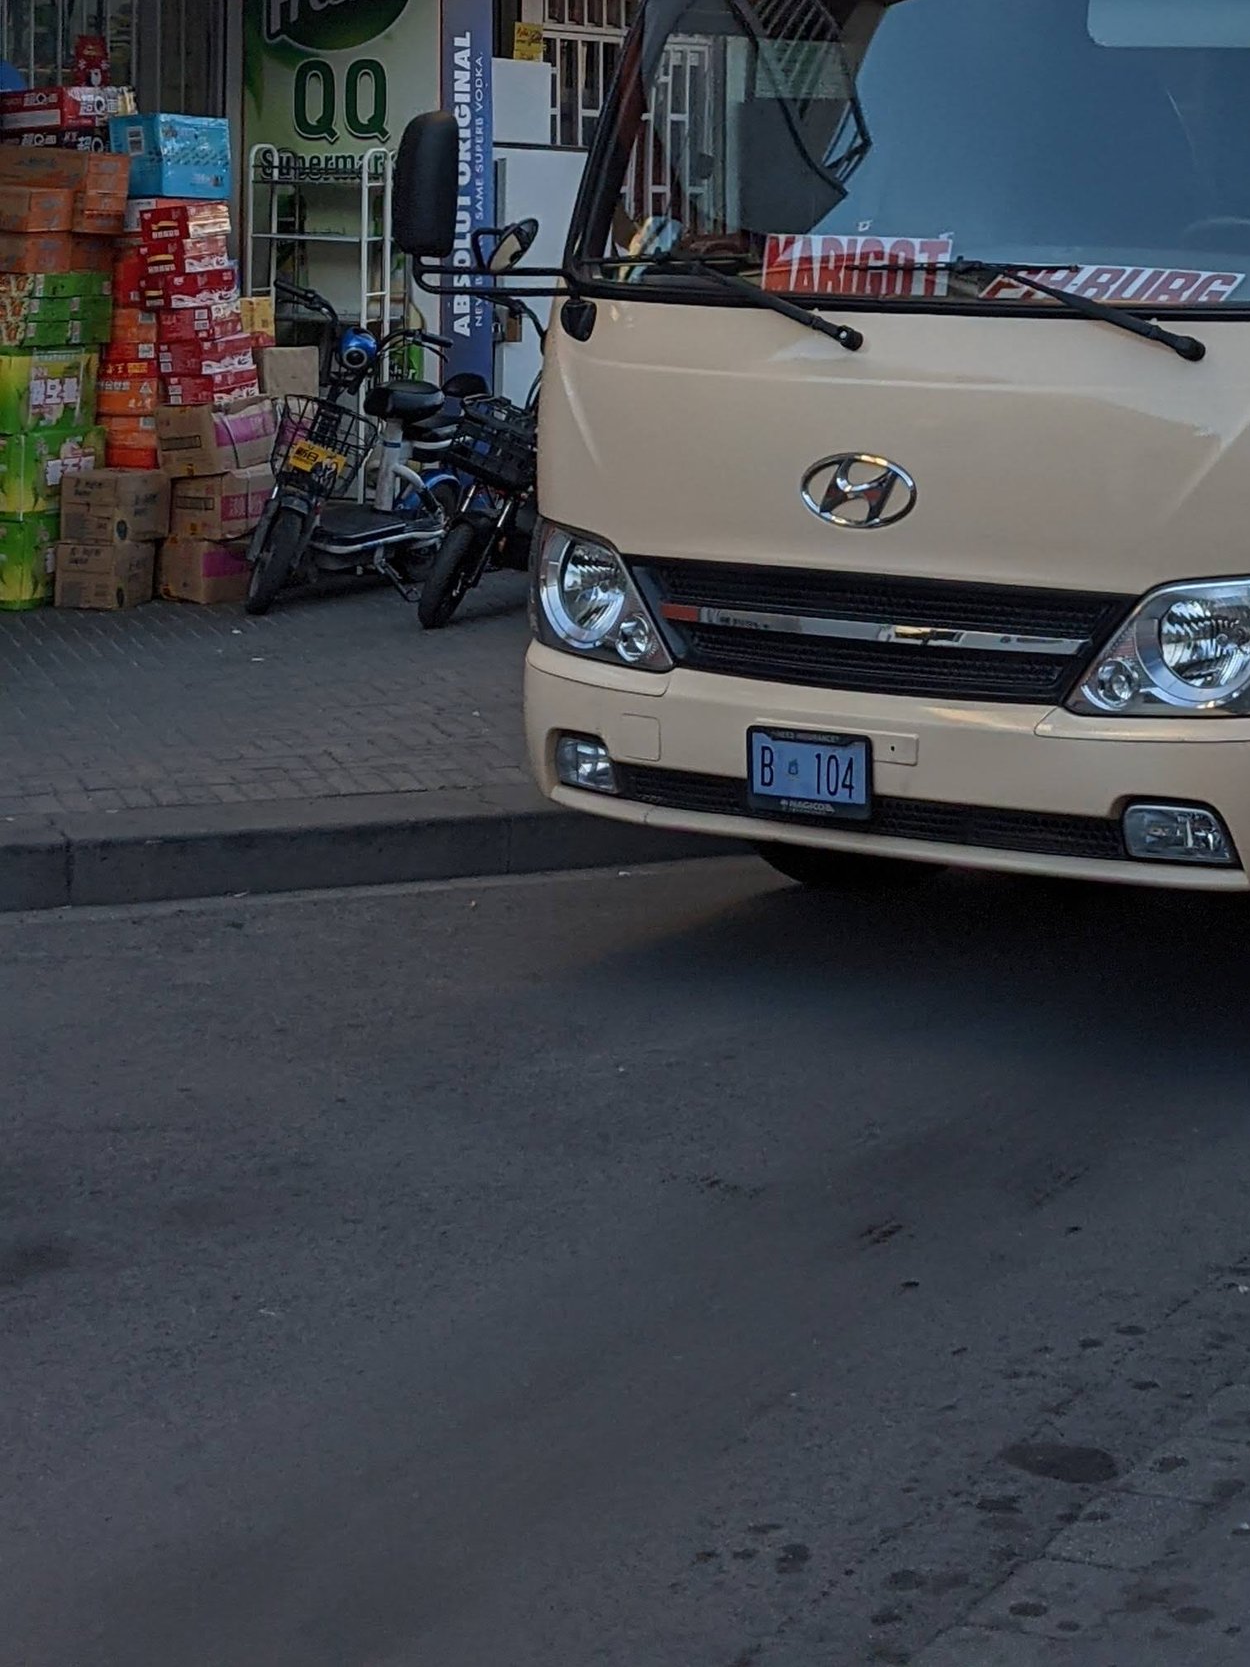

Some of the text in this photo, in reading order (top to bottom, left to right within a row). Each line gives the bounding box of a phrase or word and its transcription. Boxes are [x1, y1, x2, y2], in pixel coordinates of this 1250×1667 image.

[293, 57, 390, 143] QQ
[474, 117, 484, 173] SUPERB
[474, 178, 484, 221] SAME
[763, 235, 951, 298] MARIGOT
[760, 745, 855, 799] B 104
